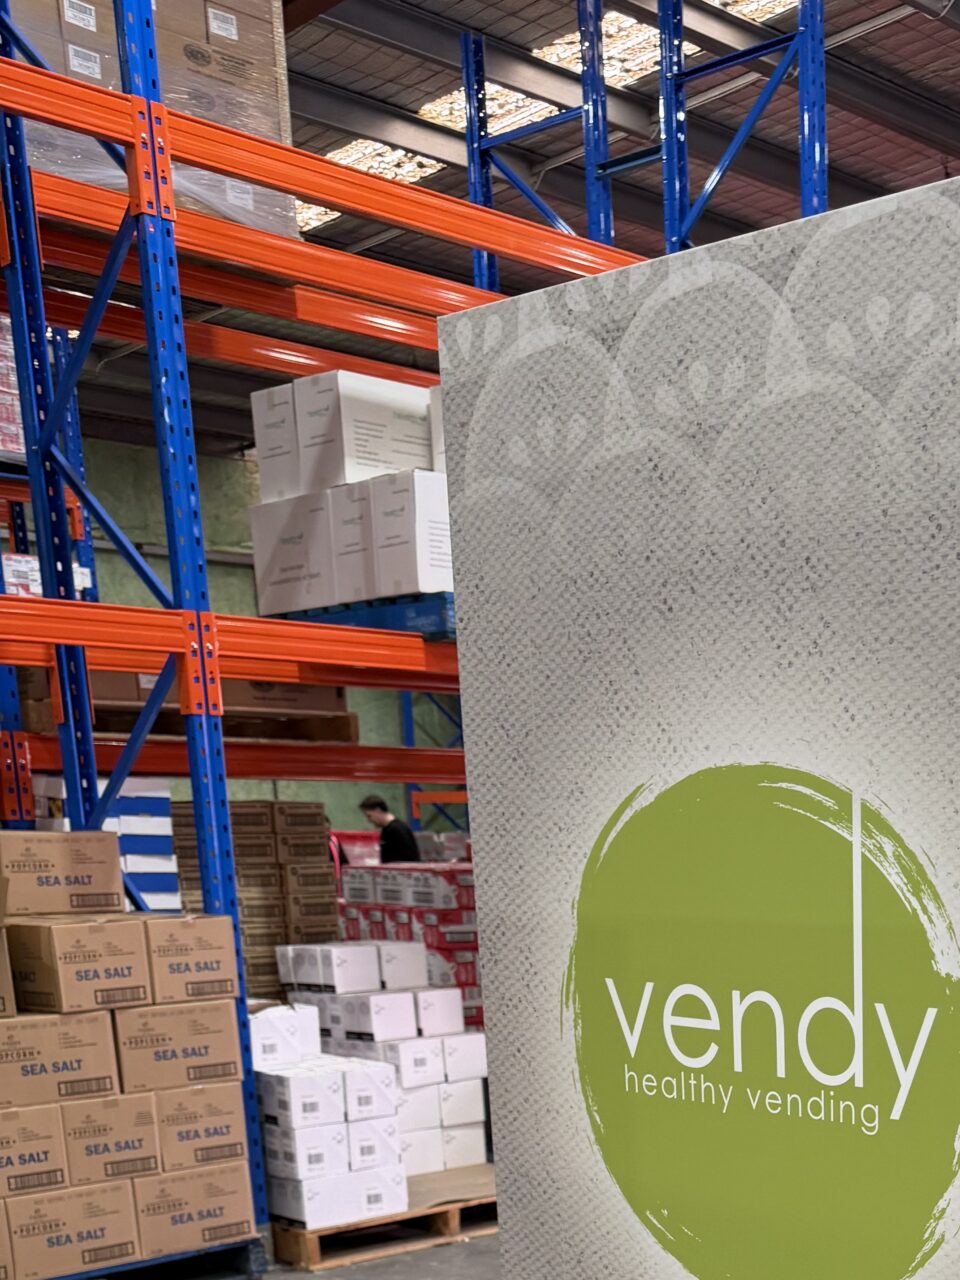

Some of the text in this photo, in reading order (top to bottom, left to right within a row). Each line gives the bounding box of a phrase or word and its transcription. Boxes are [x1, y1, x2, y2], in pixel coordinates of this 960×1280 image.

[36, 874, 93, 887] SEA SALT
[604, 791, 938, 1121] vendy
[75, 966, 133, 982] SEA SALT
[168, 960, 221, 975] SEA SALT
[154, 1045, 210, 1062] SEA SALT
[21, 1059, 83, 1077] SEA SALT
[624, 1064, 880, 1136] healthy vending
[176, 1125, 231, 1142] SEA SALT
[85, 1138, 144, 1157] SEA SALT
[18, 1151, 50, 1167] SALT
[170, 1206, 225, 1226] SEA SALT
[46, 1227, 107, 1249] SEA SALT
